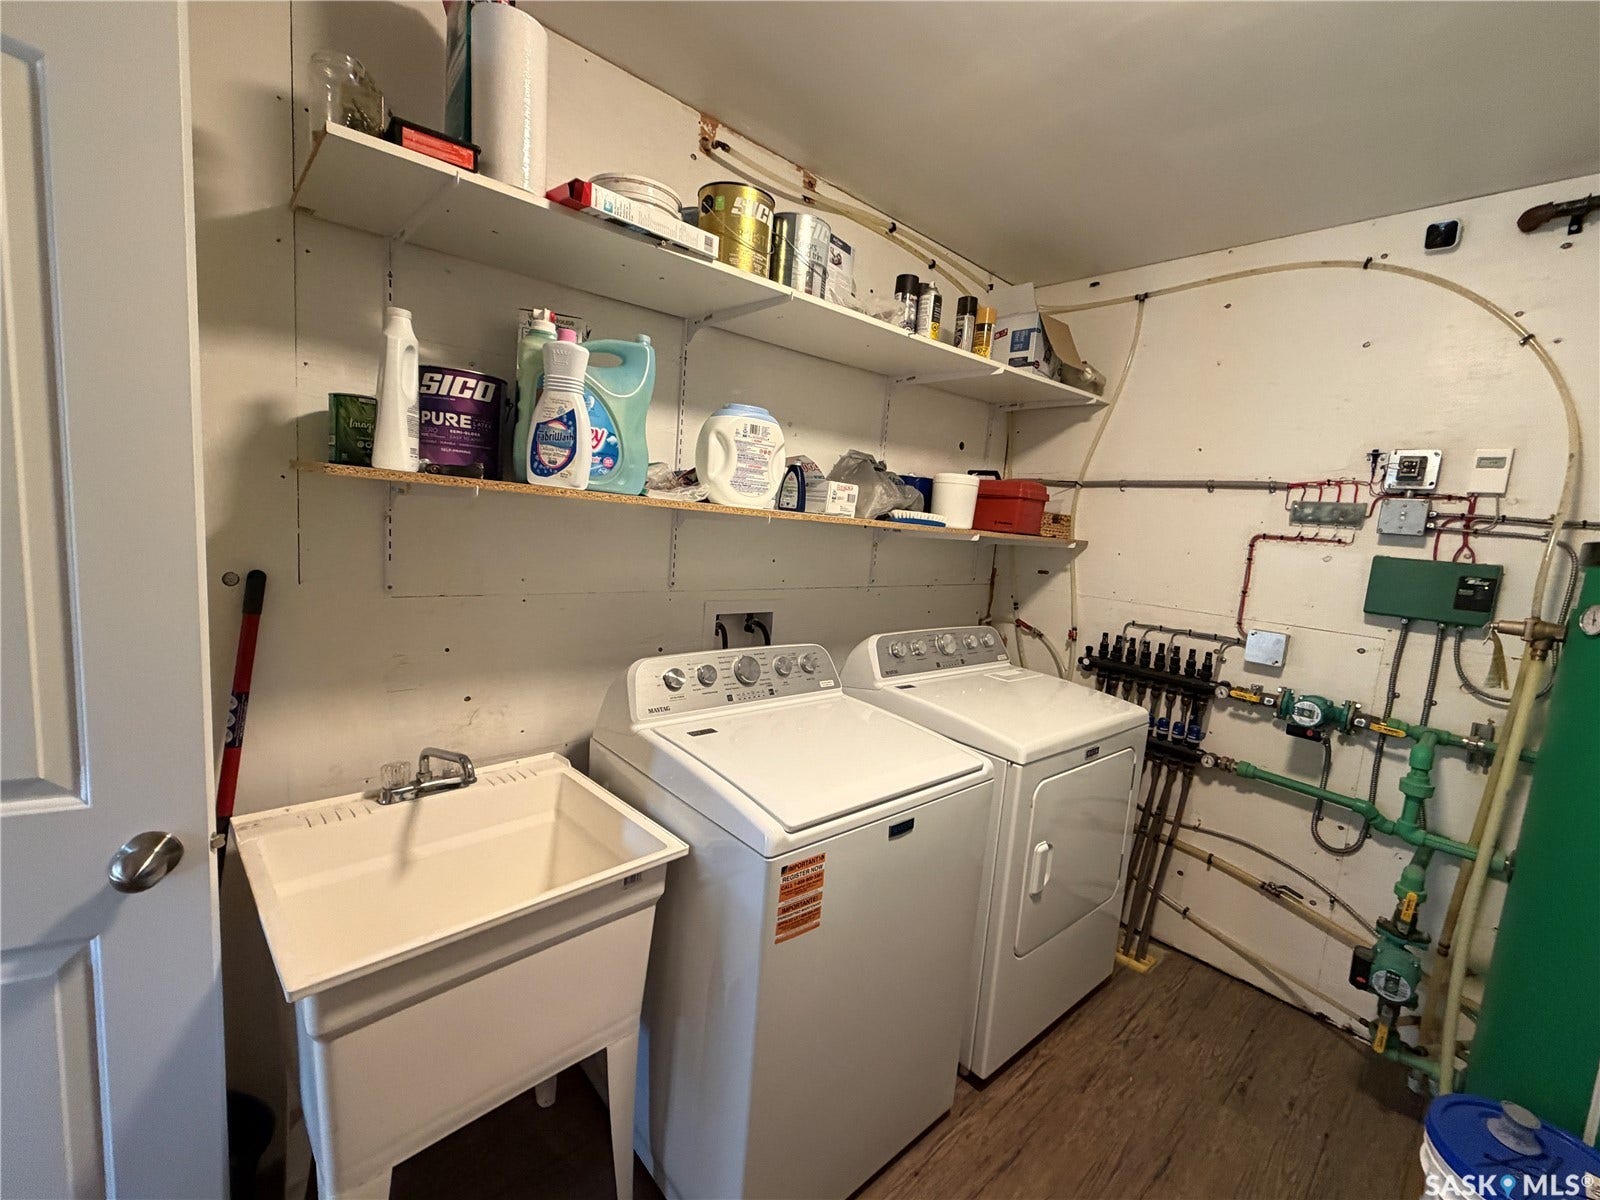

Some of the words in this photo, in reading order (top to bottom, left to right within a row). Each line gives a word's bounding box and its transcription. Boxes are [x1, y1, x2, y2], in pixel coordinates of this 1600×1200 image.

[420, 372, 496, 403] SICO
[421, 410, 472, 429] PURE
[647, 705, 671, 714] MAYTAG
[782, 869, 810, 883] REGISTER
[811, 864, 824, 873] NOW
